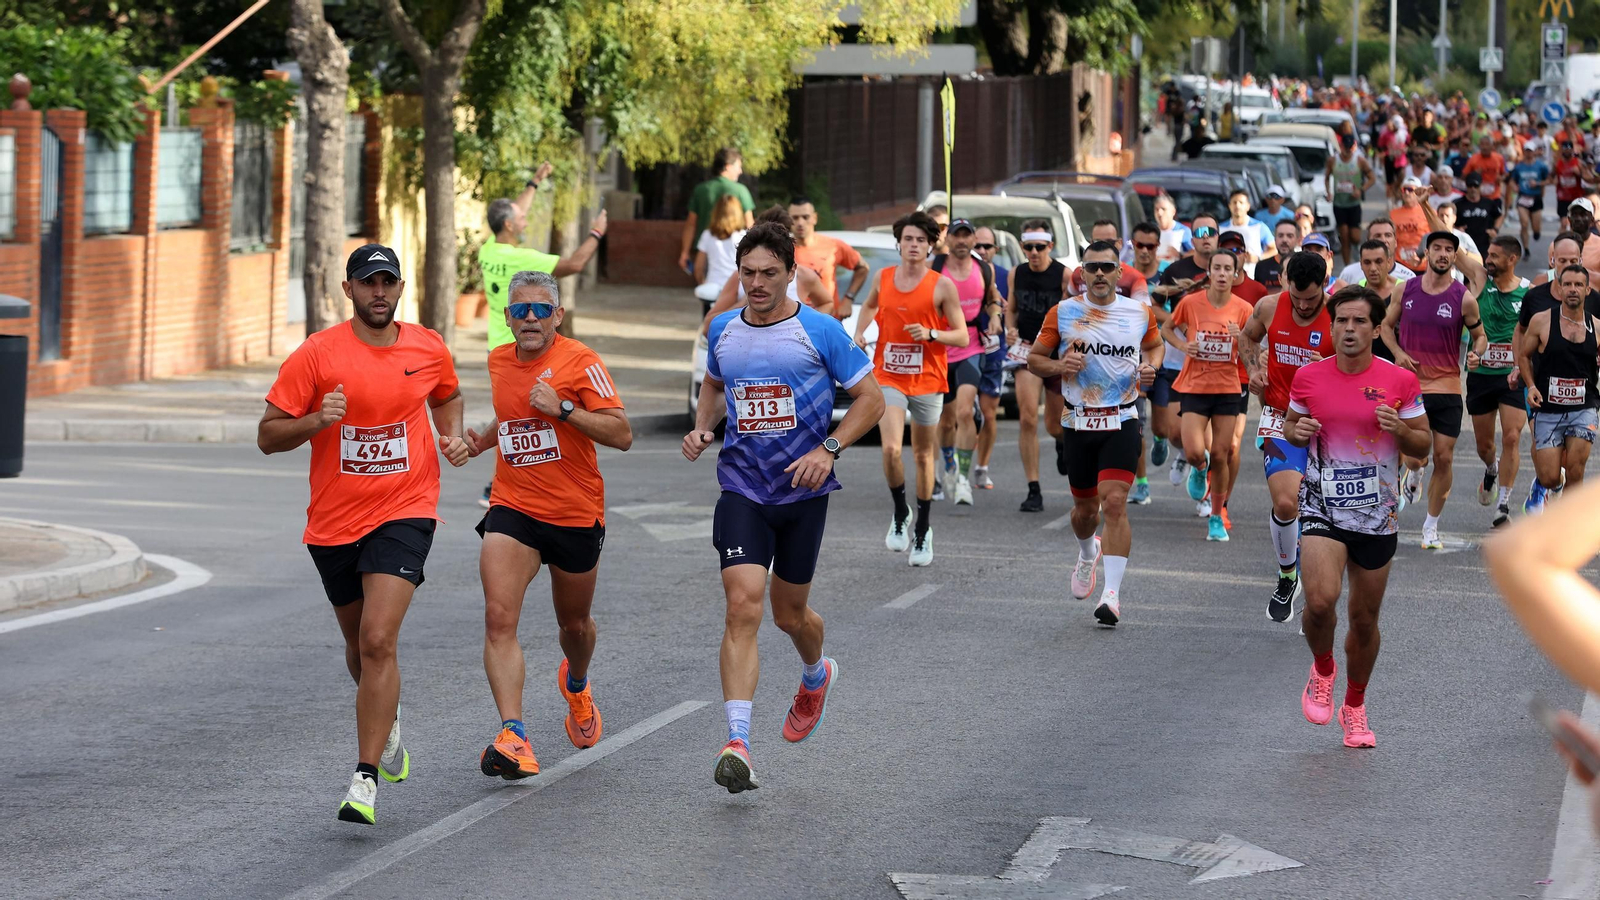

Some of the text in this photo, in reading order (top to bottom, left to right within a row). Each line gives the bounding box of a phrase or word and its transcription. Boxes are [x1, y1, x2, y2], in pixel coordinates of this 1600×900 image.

[1203, 343, 1223, 353] 462
[1274, 342, 1289, 353] CLUB
[891, 354, 912, 364] 207
[1490, 351, 1508, 360] 539
[1558, 387, 1577, 397] 508
[747, 400, 779, 418] 313
[1086, 417, 1109, 429] 471
[1270, 418, 1285, 430] 13
[511, 433, 542, 452] 500
[356, 441, 393, 460] 494
[1335, 480, 1366, 496] 808
